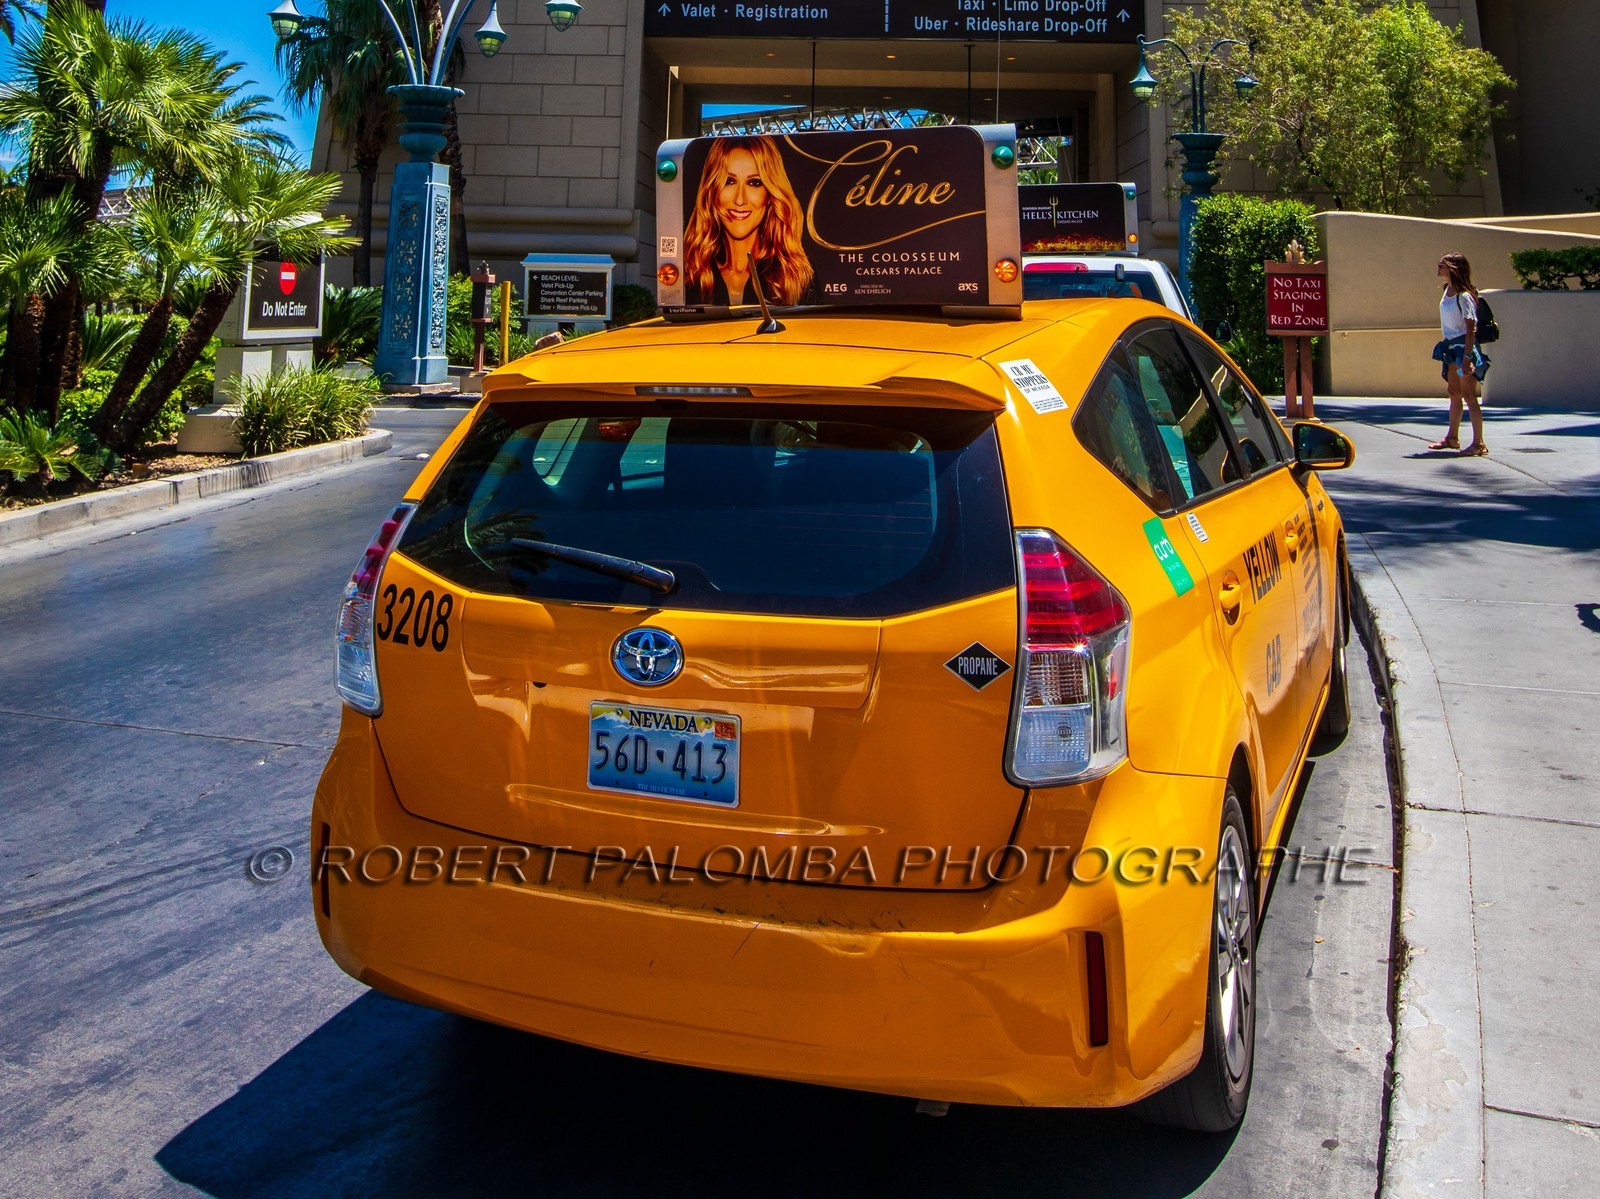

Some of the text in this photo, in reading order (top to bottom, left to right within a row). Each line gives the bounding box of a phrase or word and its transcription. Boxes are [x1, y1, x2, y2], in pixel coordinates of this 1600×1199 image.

[681, 3, 828, 21] Valet Registration
[914, 16, 1107, 35] Uber Rideshare Drop-Off
[800, 137, 972, 250] Céline
[1022, 210, 1099, 220] HELL'S KITCHEN
[838, 252, 961, 263] THE COLOSSEUM
[856, 266, 942, 276] CAESARS PALACE
[585, 290, 604, 298] Parking
[824, 283, 848, 292] AEG
[958, 282, 979, 292] axs
[262, 301, 307, 317] Do Not Enter
[1010, 364, 1035, 377] CRME
[1013, 374, 1049, 389] STOPPERS
[1153, 536, 1175, 561] curb
[1242, 531, 1282, 605] YELLOW
[376, 583, 454, 652] 3208
[958, 656, 998, 676] PROPANE
[1266, 633, 1282, 697] CAB
[628, 709, 699, 734] NEVADA
